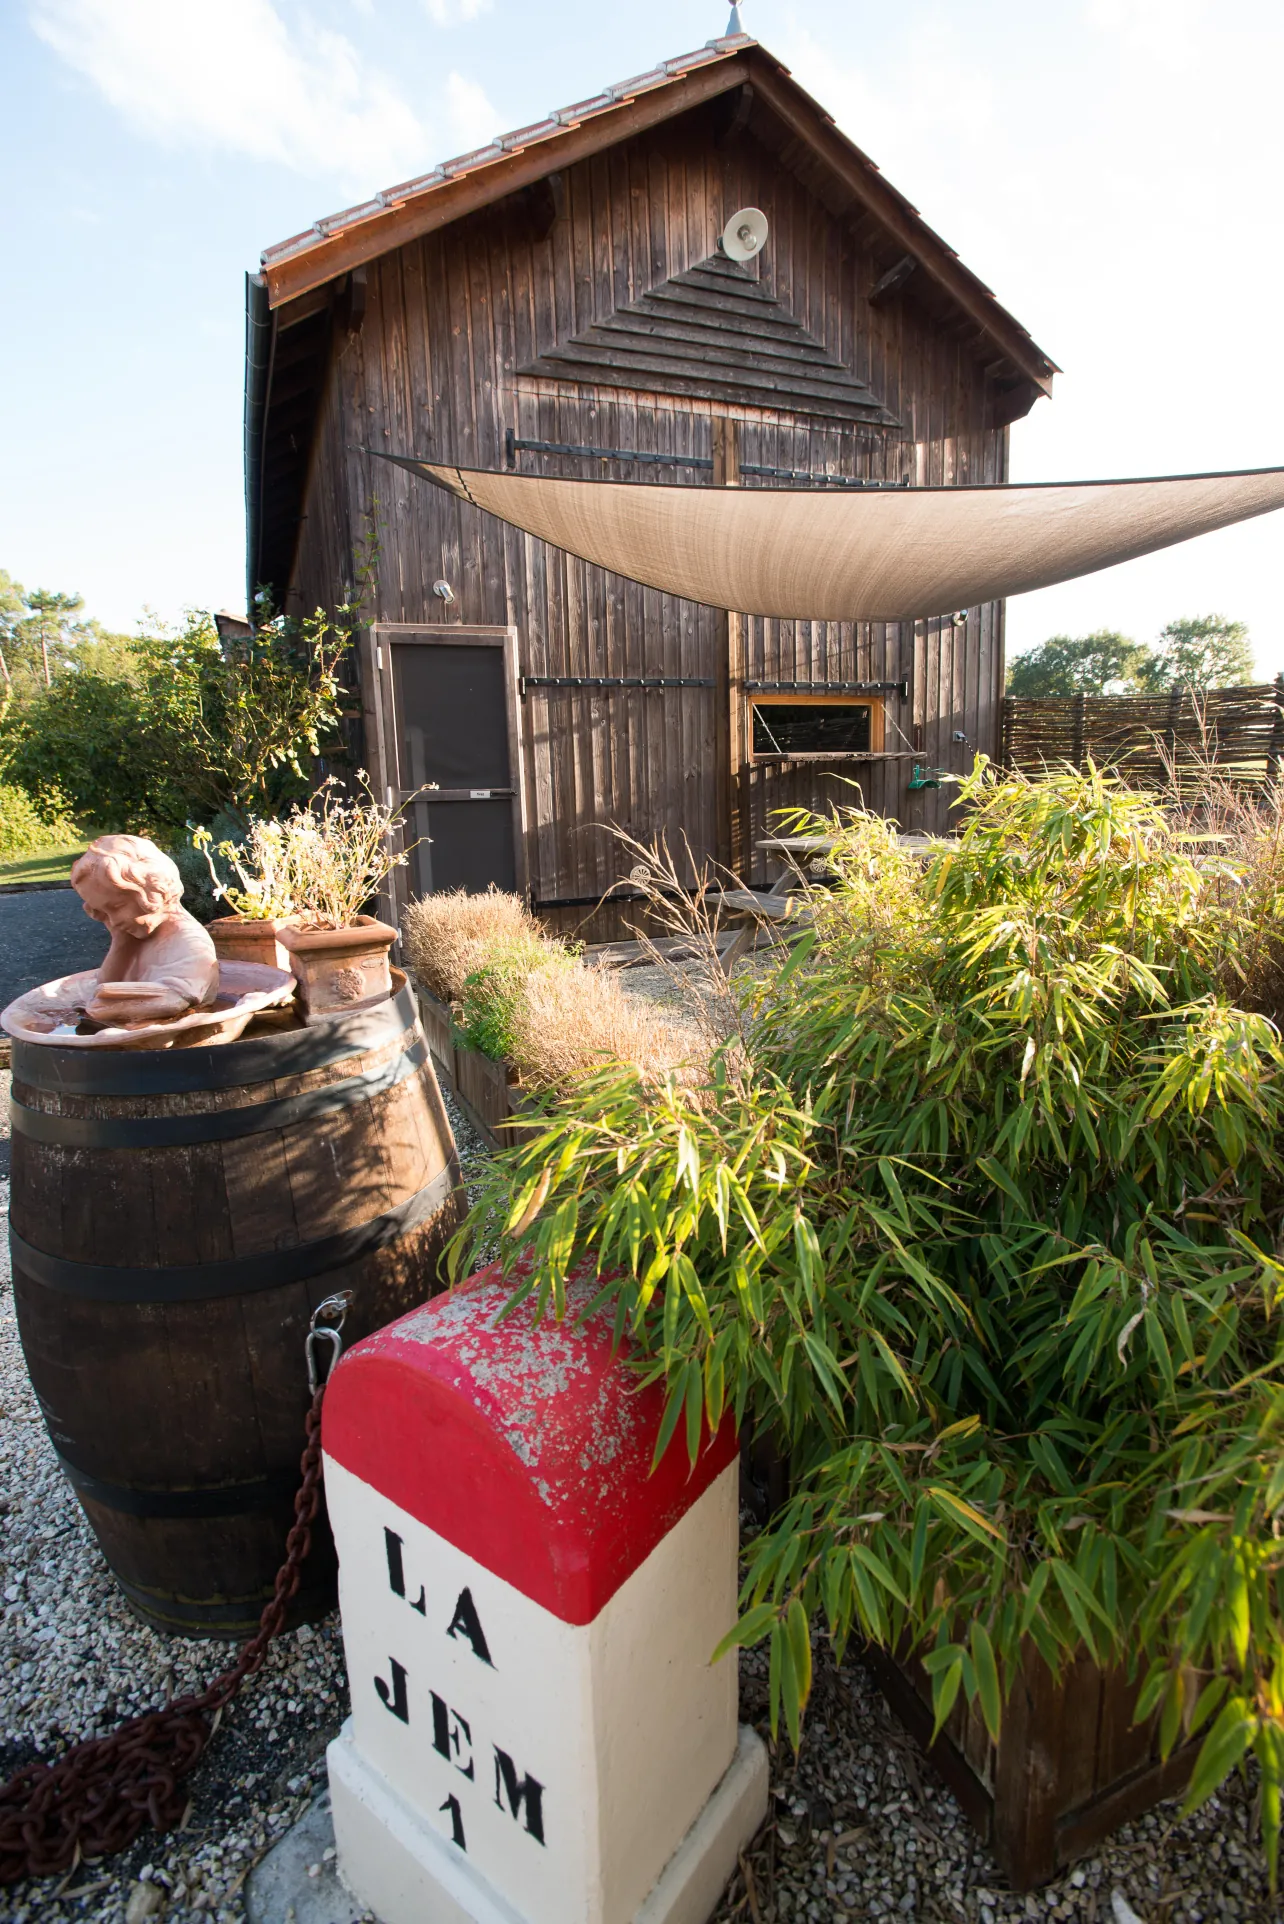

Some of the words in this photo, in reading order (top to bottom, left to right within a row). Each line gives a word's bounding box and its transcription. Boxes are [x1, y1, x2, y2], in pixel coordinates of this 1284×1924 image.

[384, 1526, 497, 1670] LA
[373, 1656, 546, 1847] JEM
[439, 1793, 467, 1852] 1
